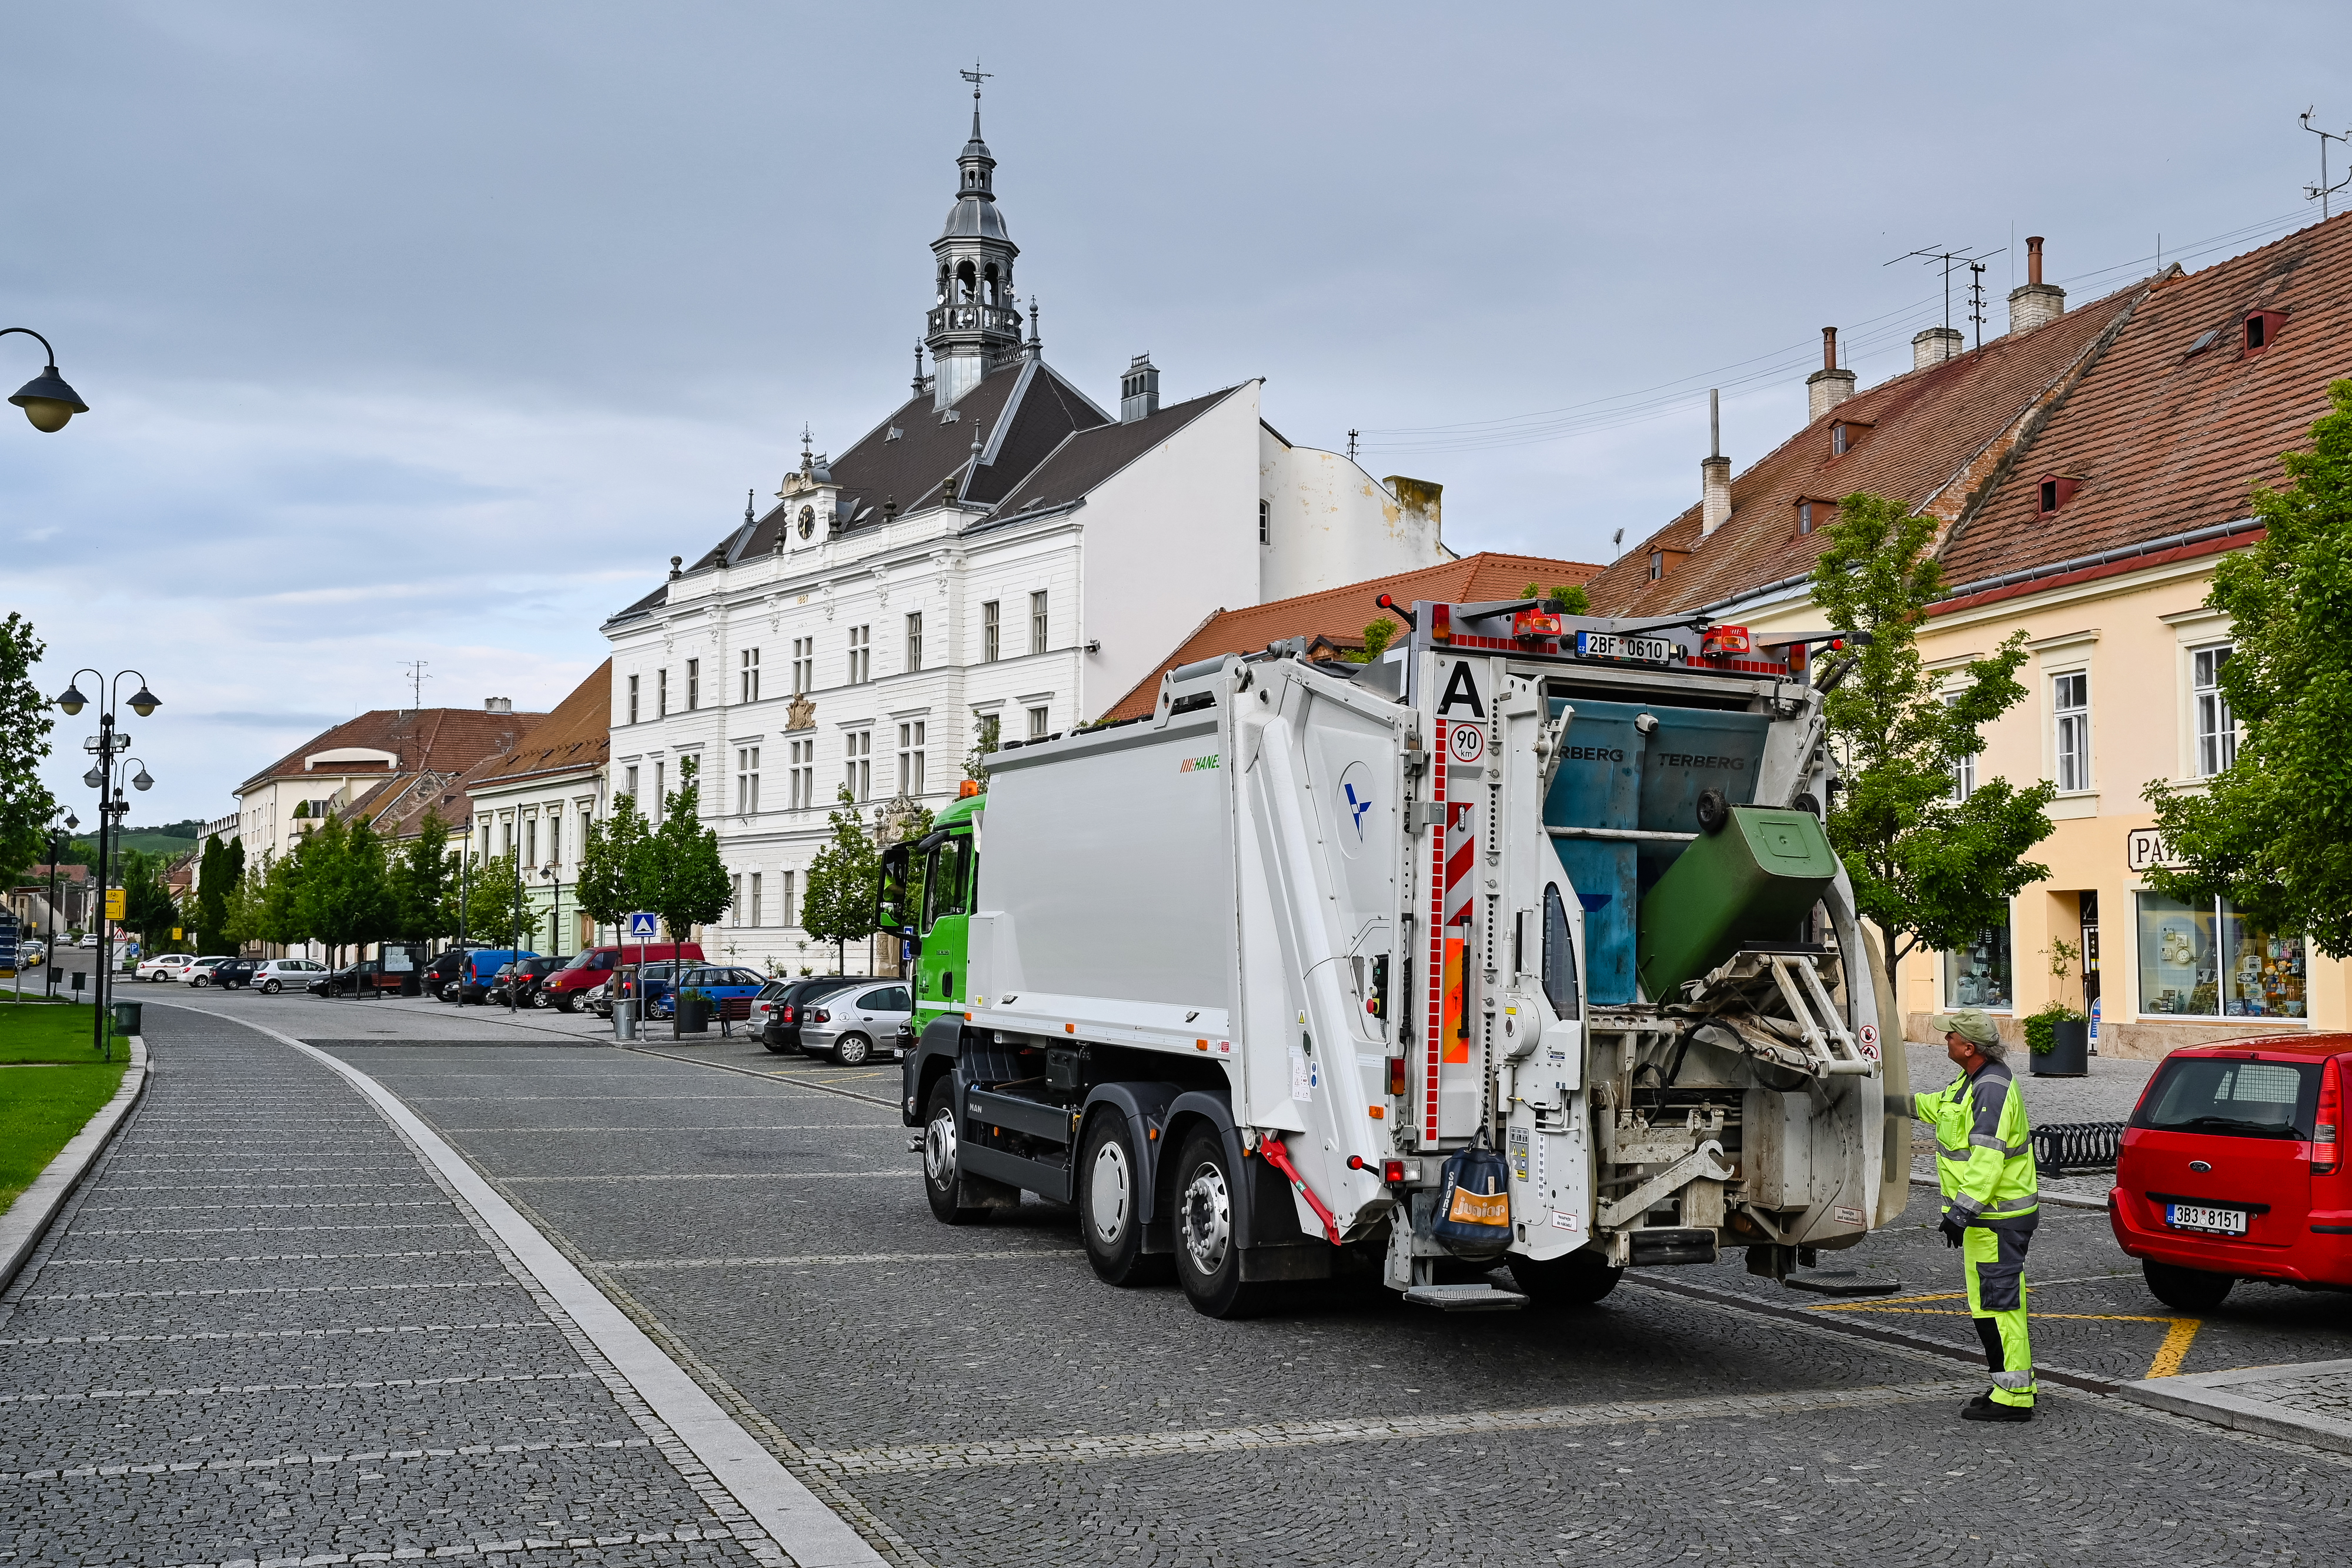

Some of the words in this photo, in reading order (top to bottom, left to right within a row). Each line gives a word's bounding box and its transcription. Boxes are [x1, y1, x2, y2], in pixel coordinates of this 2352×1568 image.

[1589, 636, 1616, 654] 2BF
[1627, 639, 1662, 658] 0610
[1436, 660, 1485, 718] A
[1457, 730, 1477, 750] 90
[1461, 749, 1472, 758] km
[1658, 753, 1745, 771] TERBERG
[970, 1103, 982, 1114] MAN
[1442, 1171, 1455, 1218] SPORT
[1453, 1196, 1505, 1218] junior
[2176, 1206, 2199, 1223] 3B3
[2208, 1210, 2239, 1229] 8151
